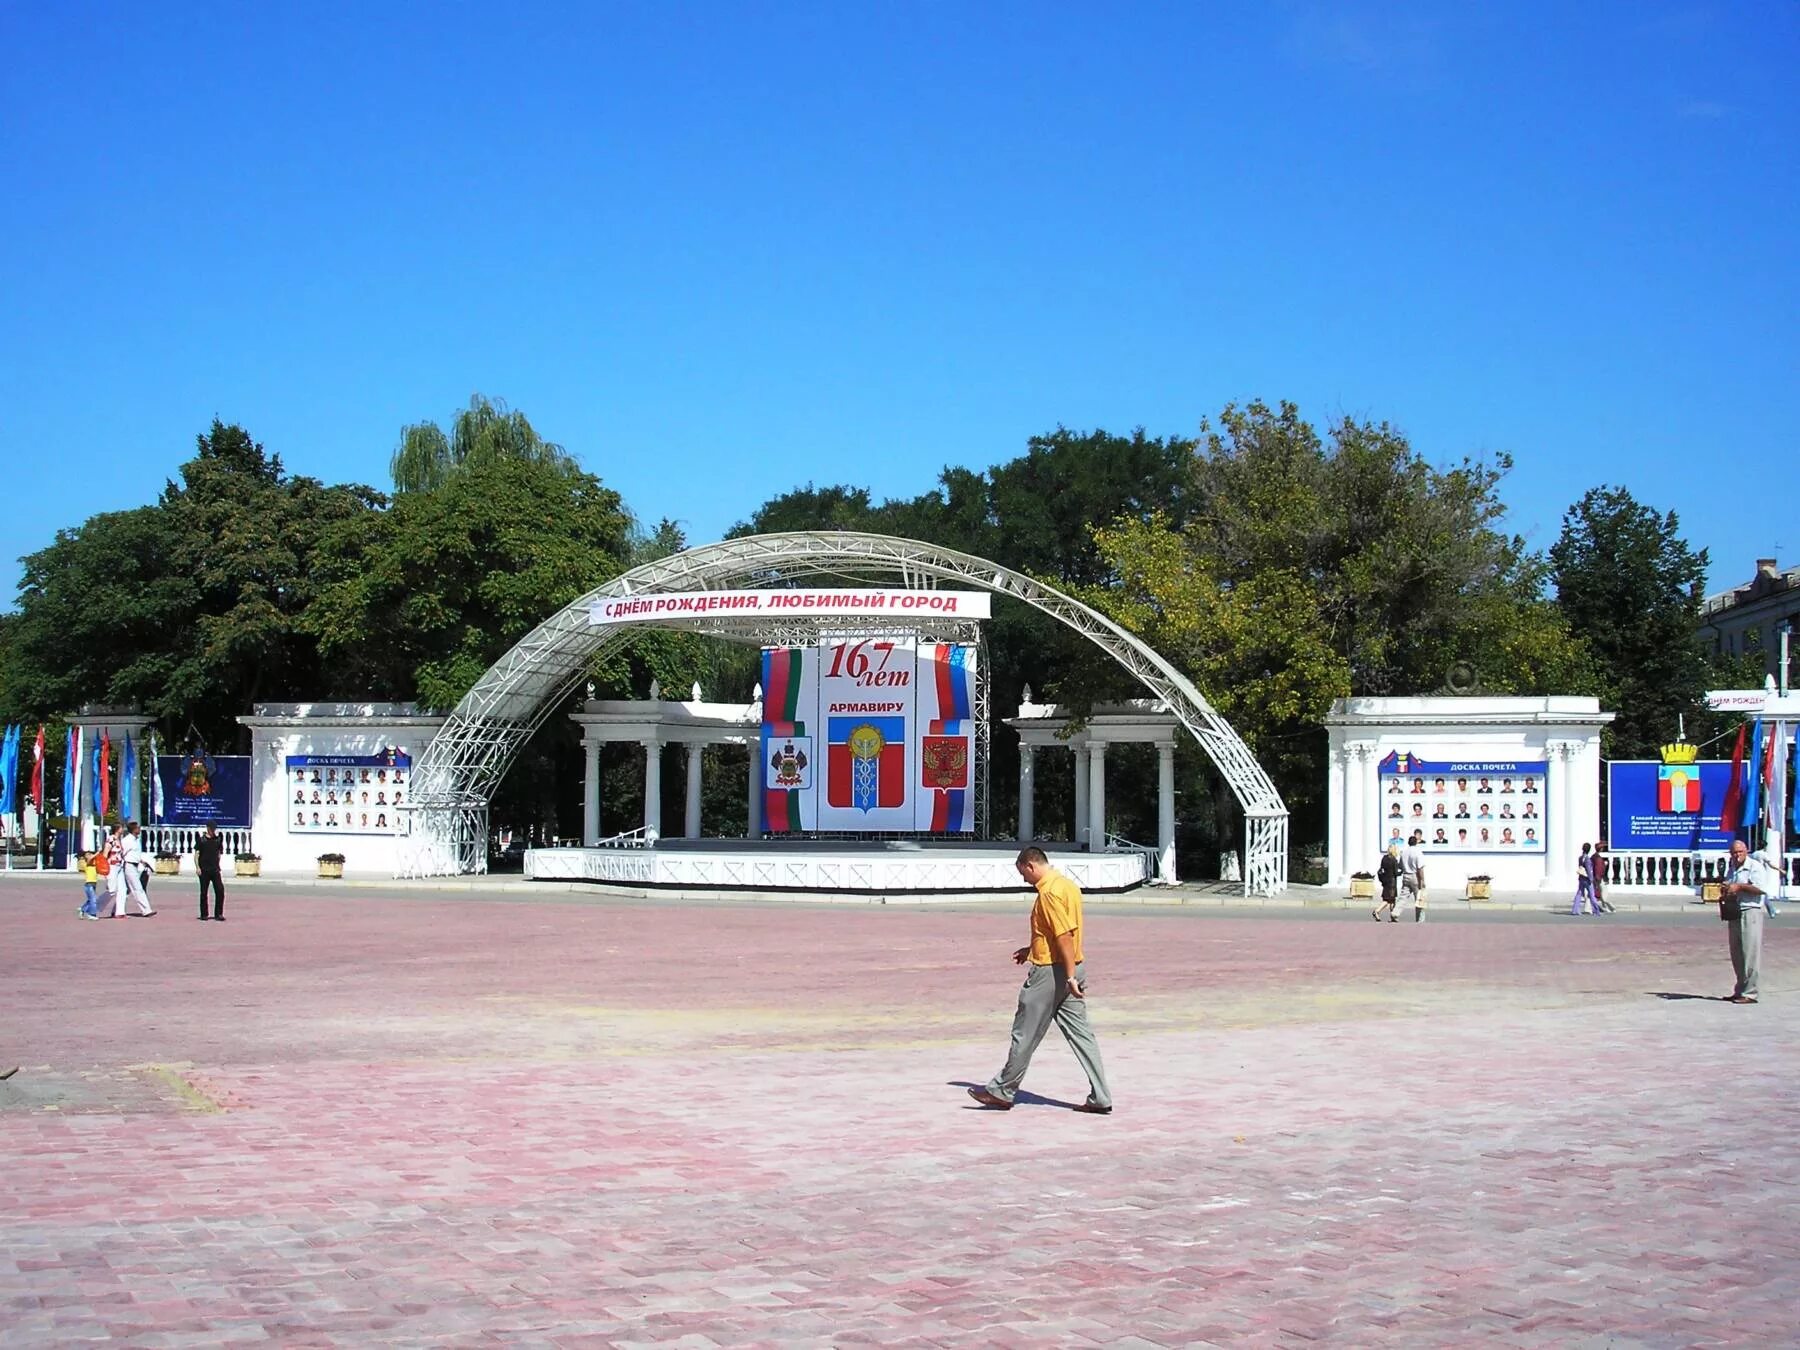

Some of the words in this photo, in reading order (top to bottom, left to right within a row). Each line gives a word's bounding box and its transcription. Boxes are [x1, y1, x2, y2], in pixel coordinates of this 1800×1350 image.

[605, 604, 613, 617] С
[613, 598, 652, 618] ДНЁМ
[655, 595, 763, 613] РОЖДЕНИЯ,
[767, 592, 886, 608] ЛЮБИМЫЙ
[889, 595, 958, 612] ГОРОД
[824, 638, 895, 678] 167
[856, 669, 910, 687] лет
[829, 702, 904, 713] АРМАВИРУ
